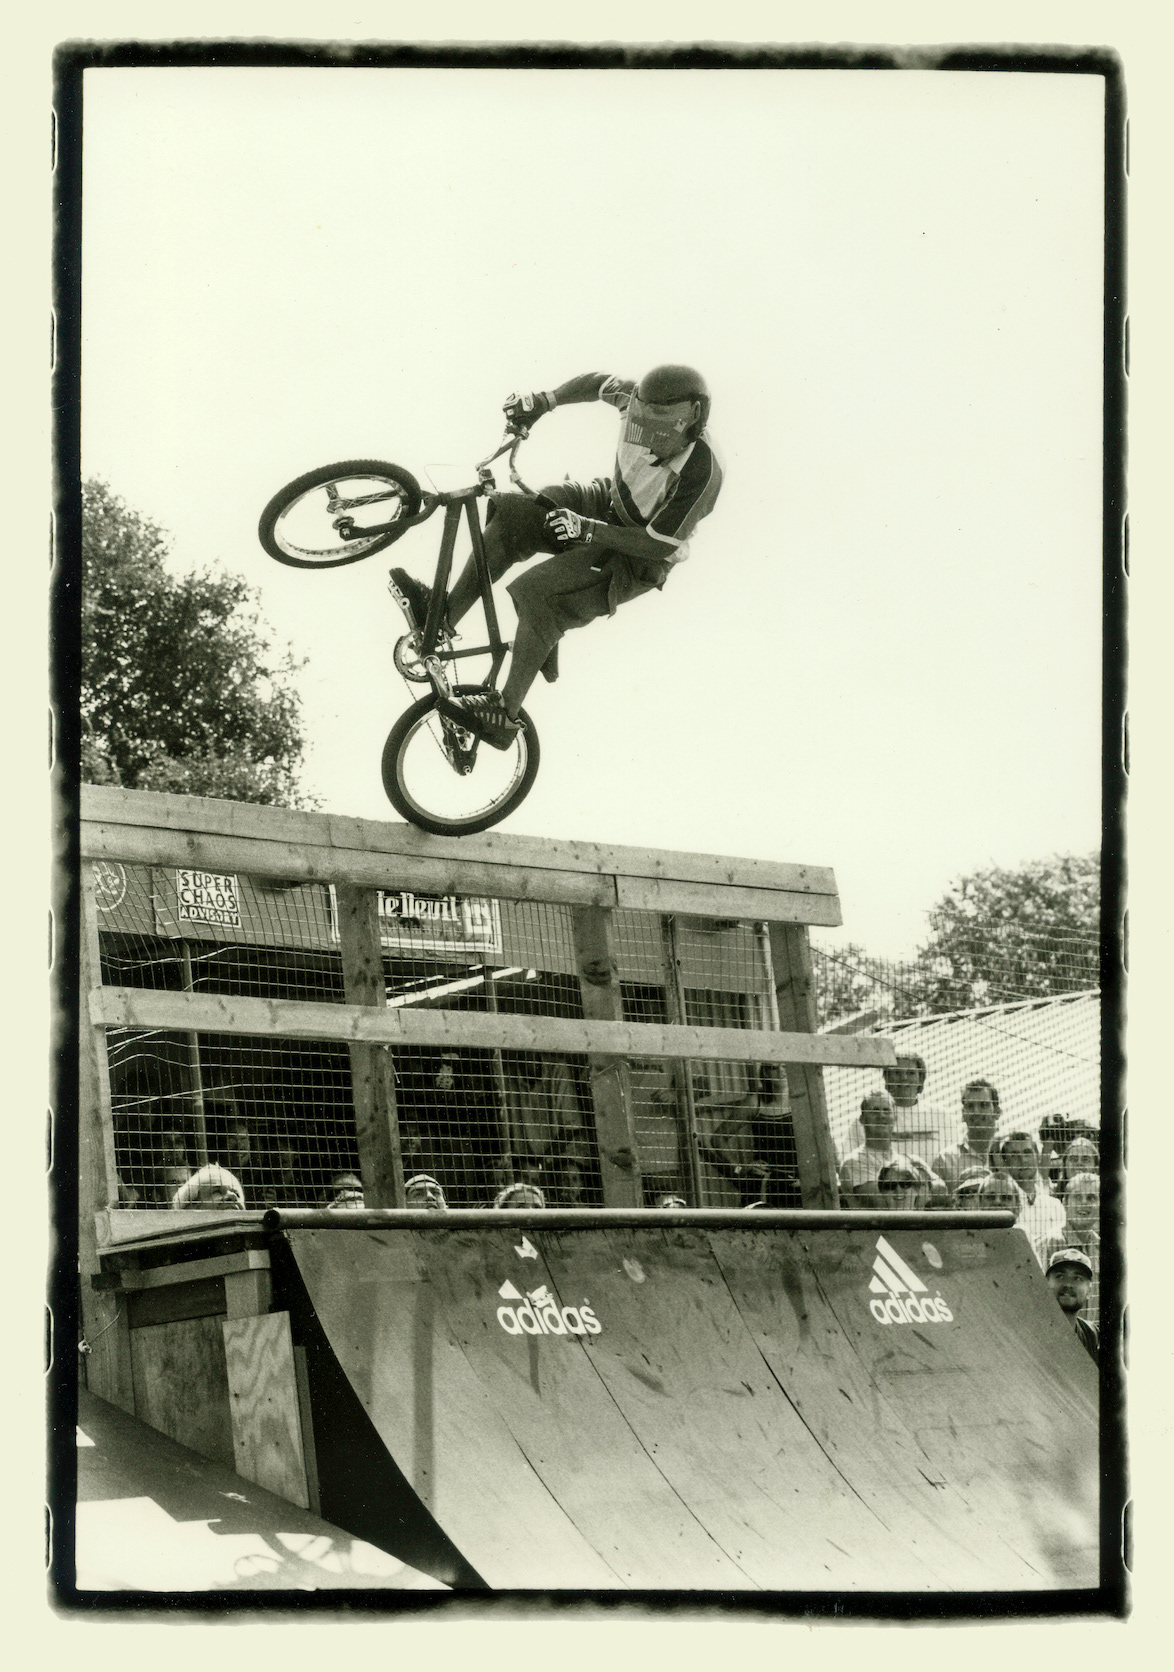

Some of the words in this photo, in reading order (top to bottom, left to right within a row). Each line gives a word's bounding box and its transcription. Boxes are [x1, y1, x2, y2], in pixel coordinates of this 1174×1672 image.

[181, 871, 233, 893] SUPER
[181, 888, 236, 910] CHAOS
[180, 906, 239, 925] ADVISORY
[496, 1297, 602, 1335] adidas
[869, 1290, 954, 1325] adidas
